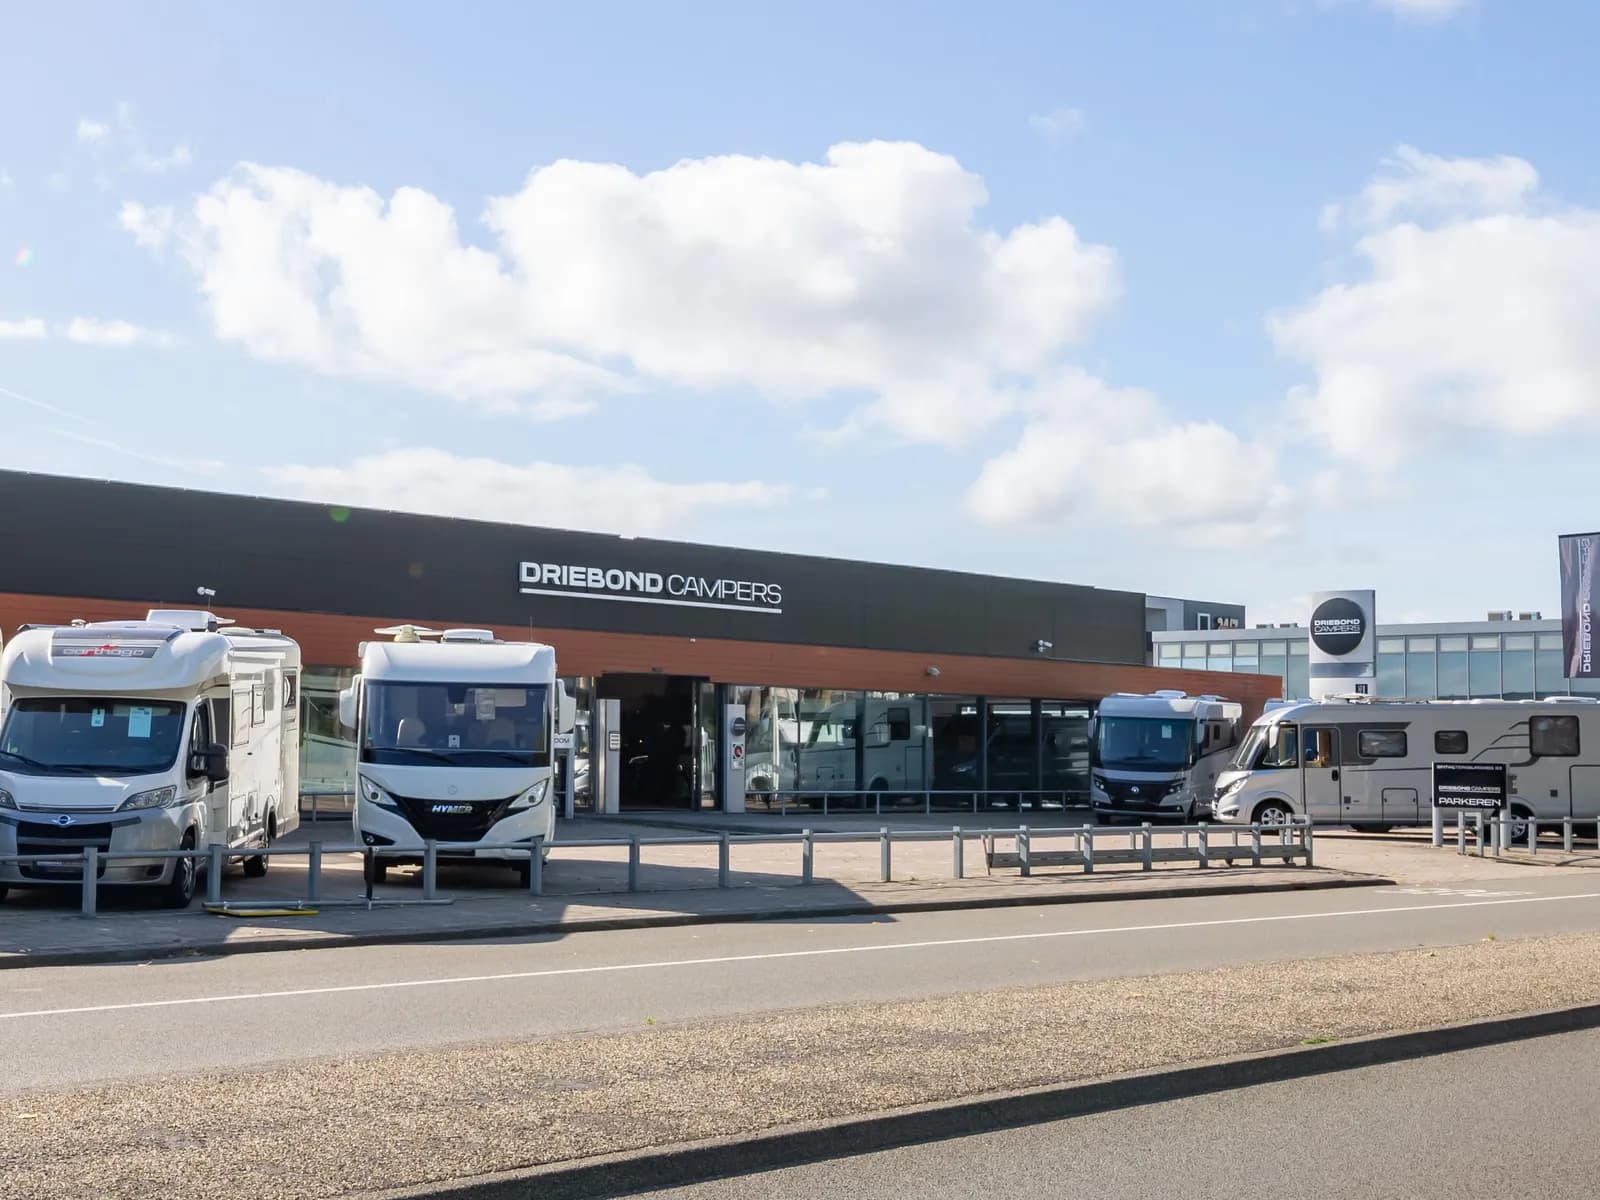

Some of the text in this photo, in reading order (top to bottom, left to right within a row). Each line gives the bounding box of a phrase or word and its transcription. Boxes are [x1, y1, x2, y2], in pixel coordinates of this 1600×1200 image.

[519, 561, 782, 604] DRIEBOND CAMPERS
[1314, 625, 1361, 633] CAMPERS
[63, 645, 145, 657] carthago
[1438, 796, 1501, 807] PARKEREN
[431, 804, 474, 815] HYMER
